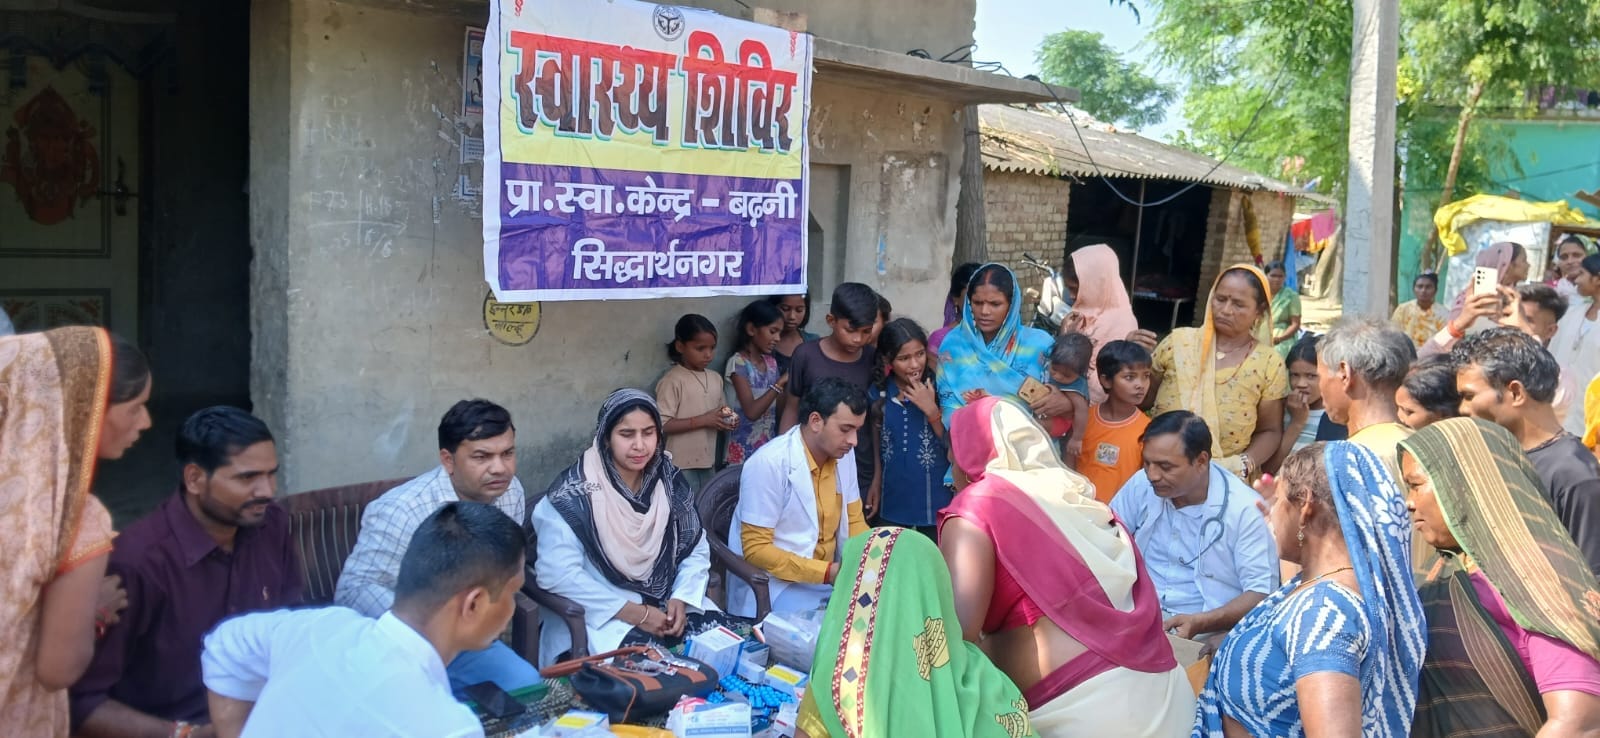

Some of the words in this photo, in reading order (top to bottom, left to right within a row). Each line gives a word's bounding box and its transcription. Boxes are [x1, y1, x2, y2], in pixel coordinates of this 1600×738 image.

[508, 30, 676, 143] स्वास्थ्य
[682, 30, 798, 152] शिविर
[506, 176, 694, 223] प्रा.स्वा.केन्द्र
[729, 181, 799, 228] बढ़नी
[571, 237, 744, 283] सिद्धार्थनगर
